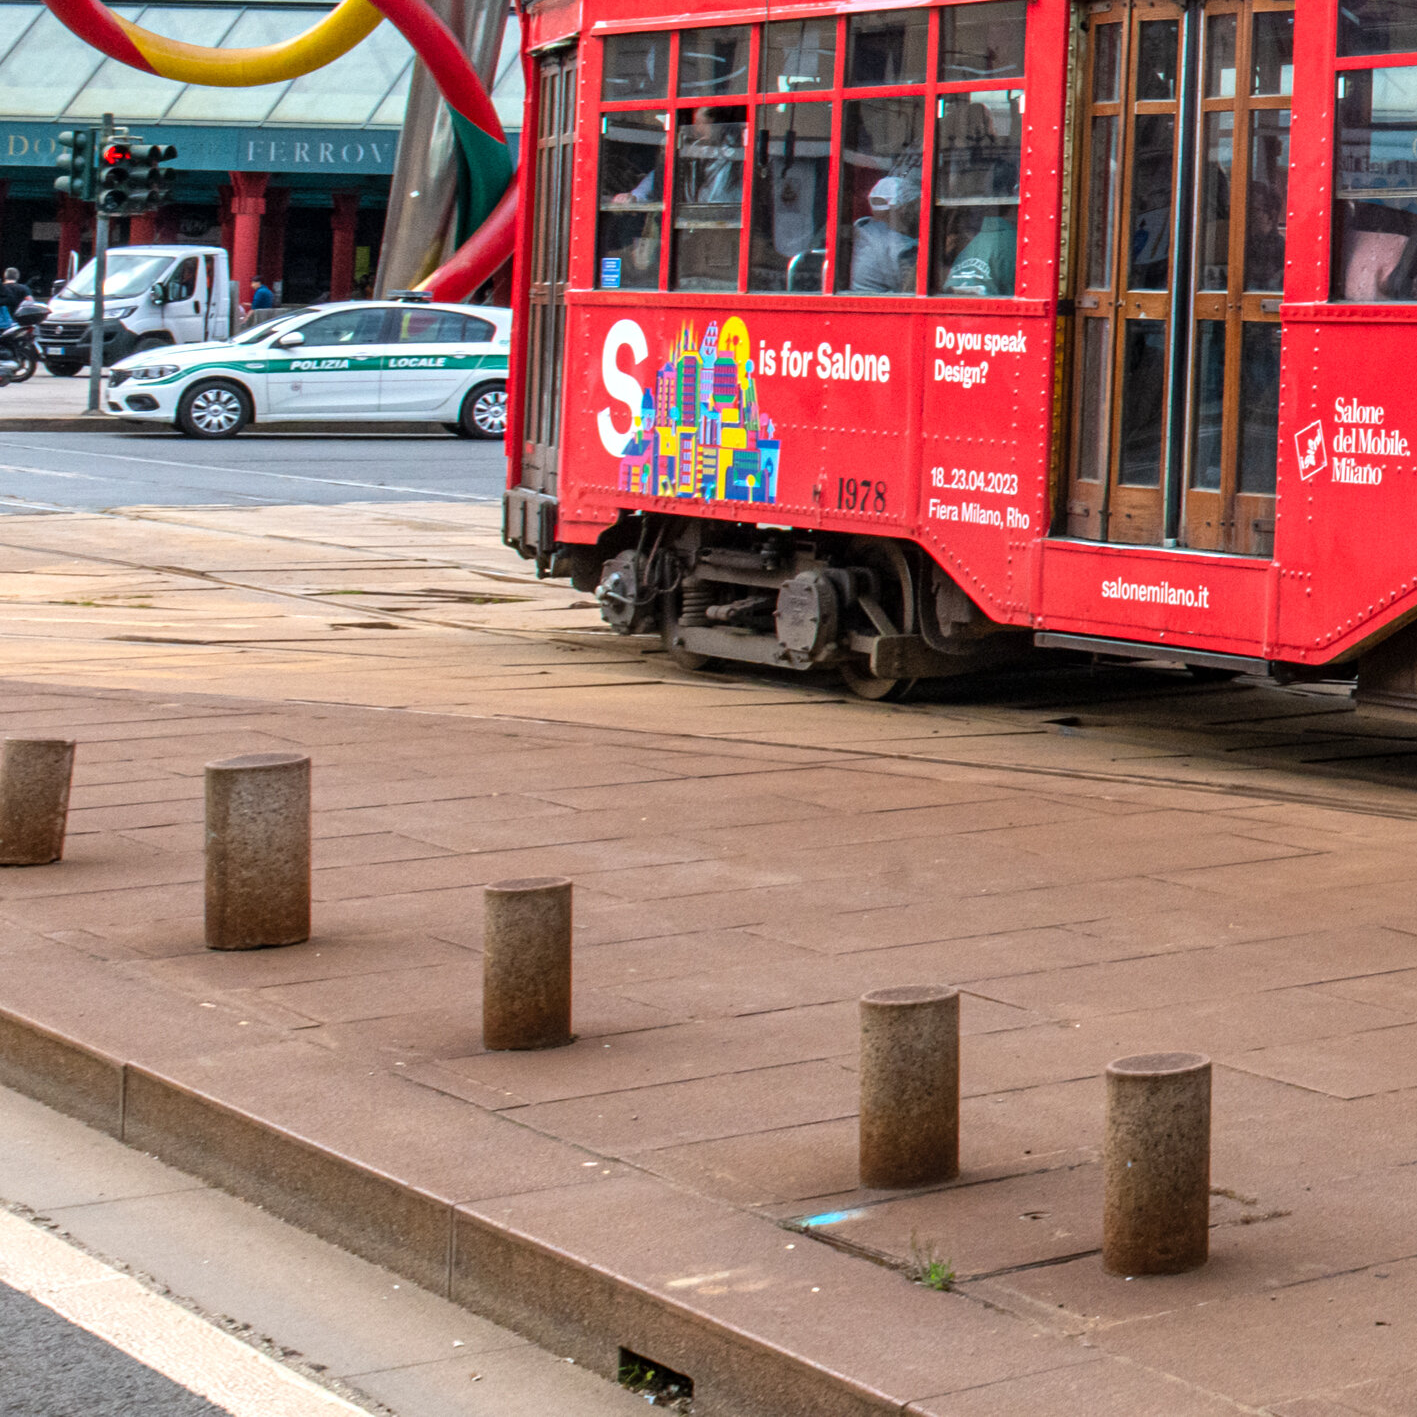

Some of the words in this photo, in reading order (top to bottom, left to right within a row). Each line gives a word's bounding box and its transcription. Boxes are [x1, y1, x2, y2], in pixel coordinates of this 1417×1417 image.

[247, 140, 391, 164] FERROV
[935, 326, 955, 349] Do
[956, 332, 982, 356] you
[984, 329, 1027, 356] speak
[290, 359, 350, 371] POLIZIA
[388, 357, 447, 369] LOCALE
[758, 341, 777, 376] is
[780, 341, 812, 378] for
[816, 342, 891, 383] Salone
[934, 358, 989, 389] Design?
[597, 318, 649, 458] S
[1334, 396, 1385, 425] Salone
[1333, 427, 1356, 453] del
[1357, 428, 1411, 457] Mobile.
[930, 467, 1019, 496] 18_23.04.2023
[1331, 456, 1383, 485] Milano
[837, 477, 887, 514] 1978
[928, 499, 959, 523] Fiera
[960, 502, 1004, 530] Milano,
[1006, 505, 1030, 531] Rho
[1101, 577, 1210, 609] salonemilano.it
